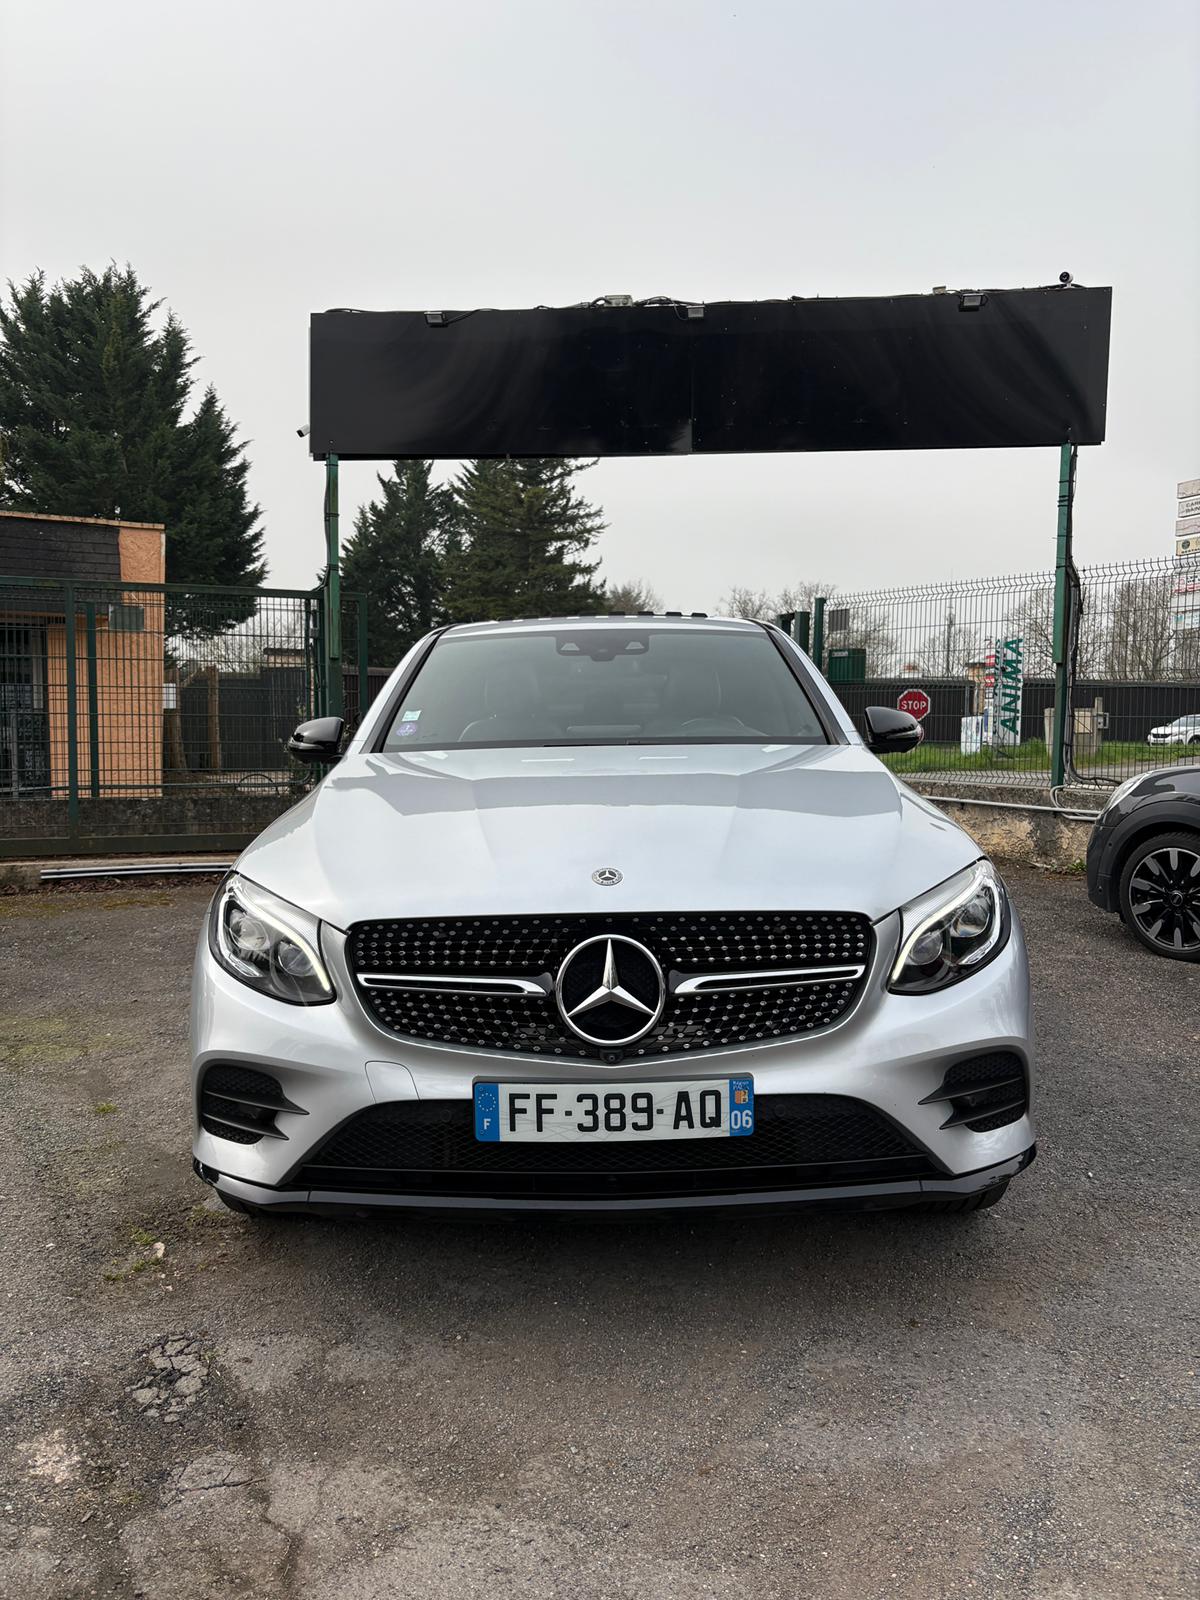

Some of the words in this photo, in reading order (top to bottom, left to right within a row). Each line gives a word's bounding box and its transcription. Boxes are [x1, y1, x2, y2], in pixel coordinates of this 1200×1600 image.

[1000, 638, 1023, 736] ANIMA
[901, 700, 927, 711] STOP
[508, 1089, 722, 1133] FF-389-AQ
[731, 1110, 752, 1130] 06
[483, 1118, 491, 1131] F
